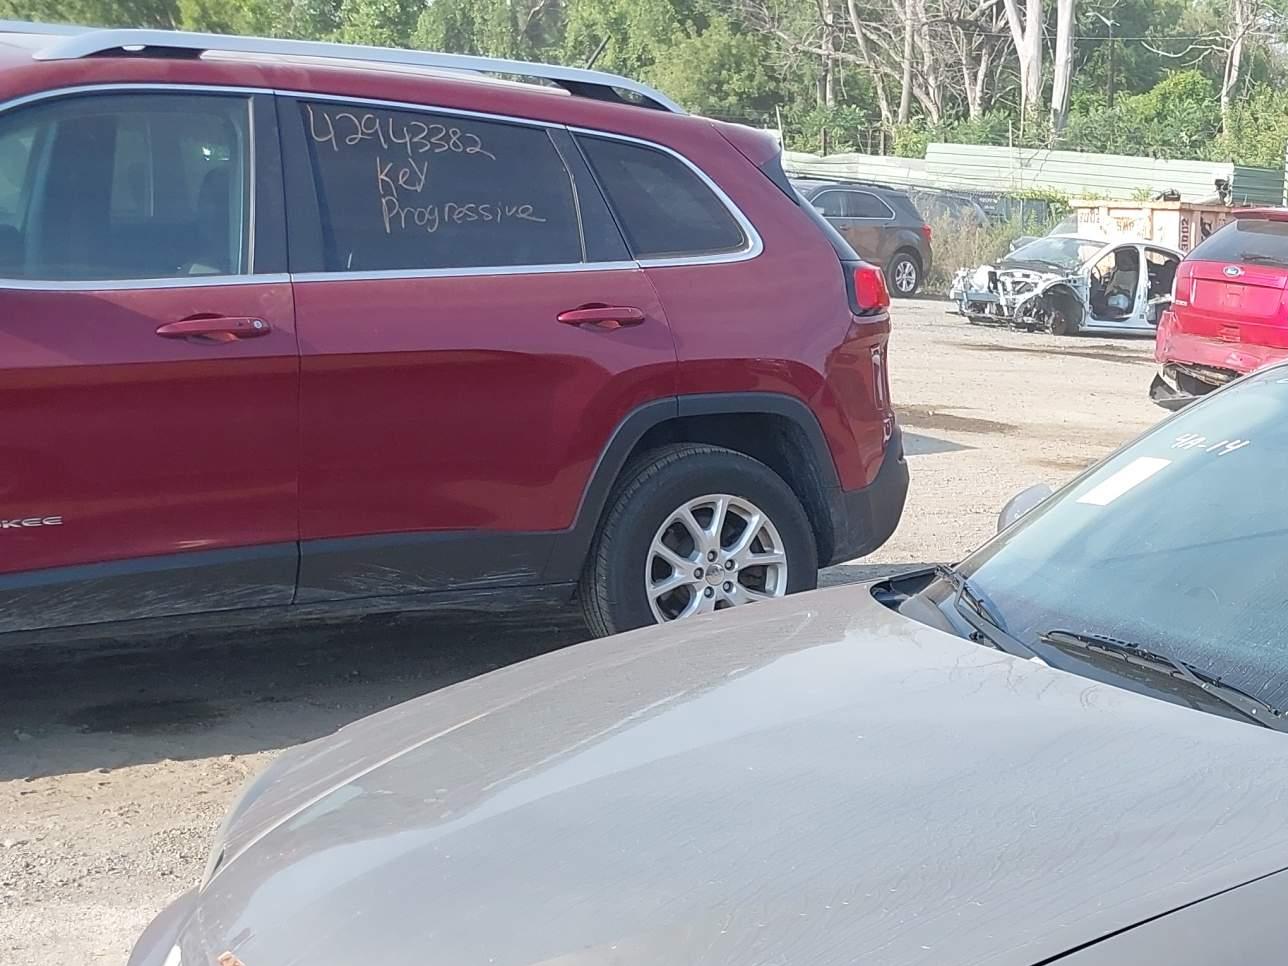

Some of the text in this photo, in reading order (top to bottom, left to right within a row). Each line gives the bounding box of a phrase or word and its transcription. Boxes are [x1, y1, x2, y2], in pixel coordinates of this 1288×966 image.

[305, 104, 496, 160] 42943382
[380, 196, 546, 233] Progressive
[0, 516, 64, 528] KEE
